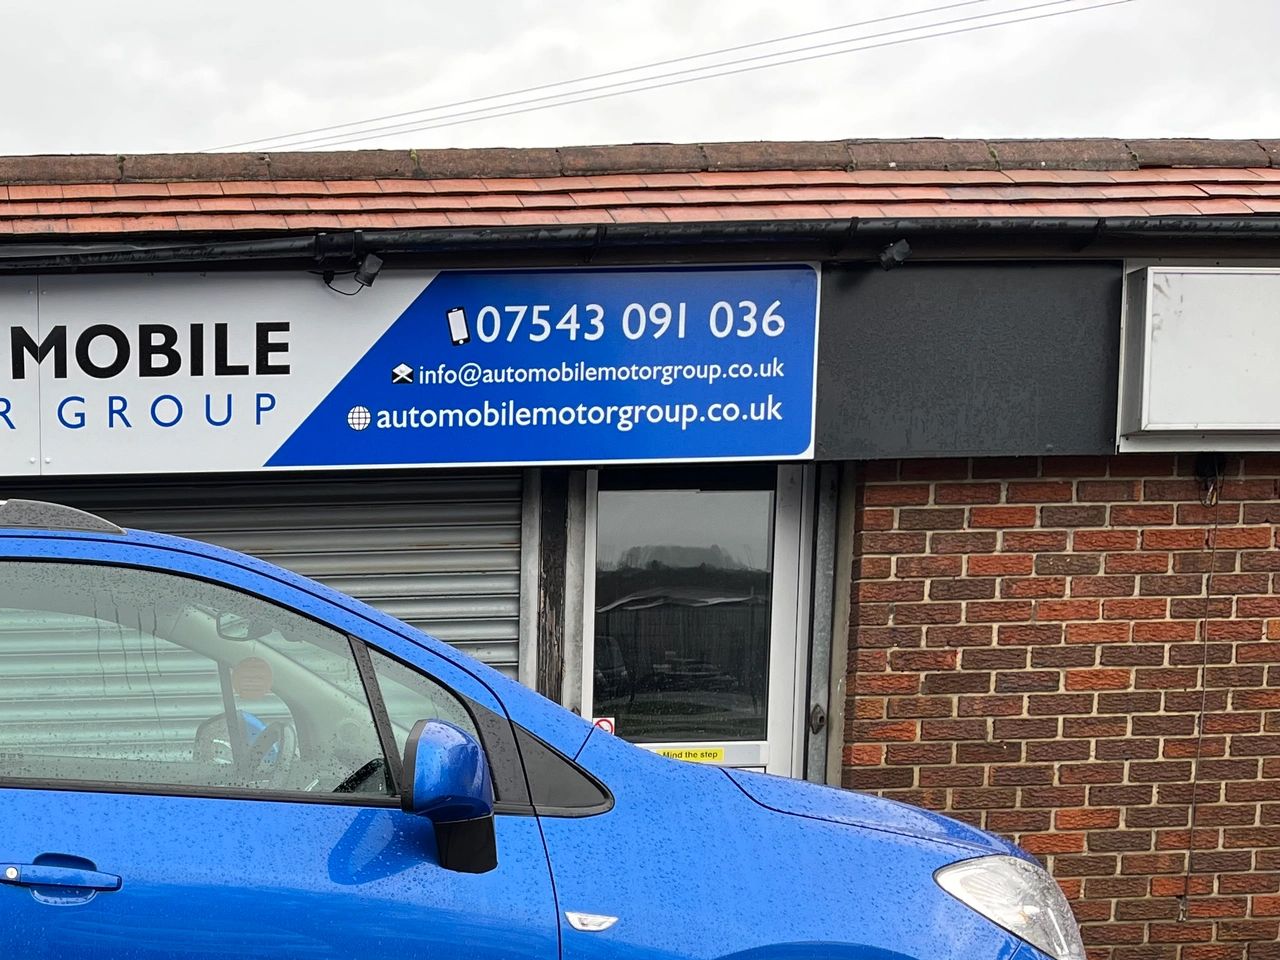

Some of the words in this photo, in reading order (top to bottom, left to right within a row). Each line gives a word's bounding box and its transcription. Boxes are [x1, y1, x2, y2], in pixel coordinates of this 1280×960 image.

[477, 304, 604, 342] 07543
[623, 303, 685, 339] 091
[710, 300, 785, 337] 036
[11, 322, 290, 379] MOBILE
[420, 357, 784, 386] info@automobilemotorgroup.co.uk
[58, 393, 275, 429] GROUP
[377, 395, 782, 431] automobilemotorgroup.co.uk
[685, 751, 698, 759] the
[700, 751, 718, 759] step
